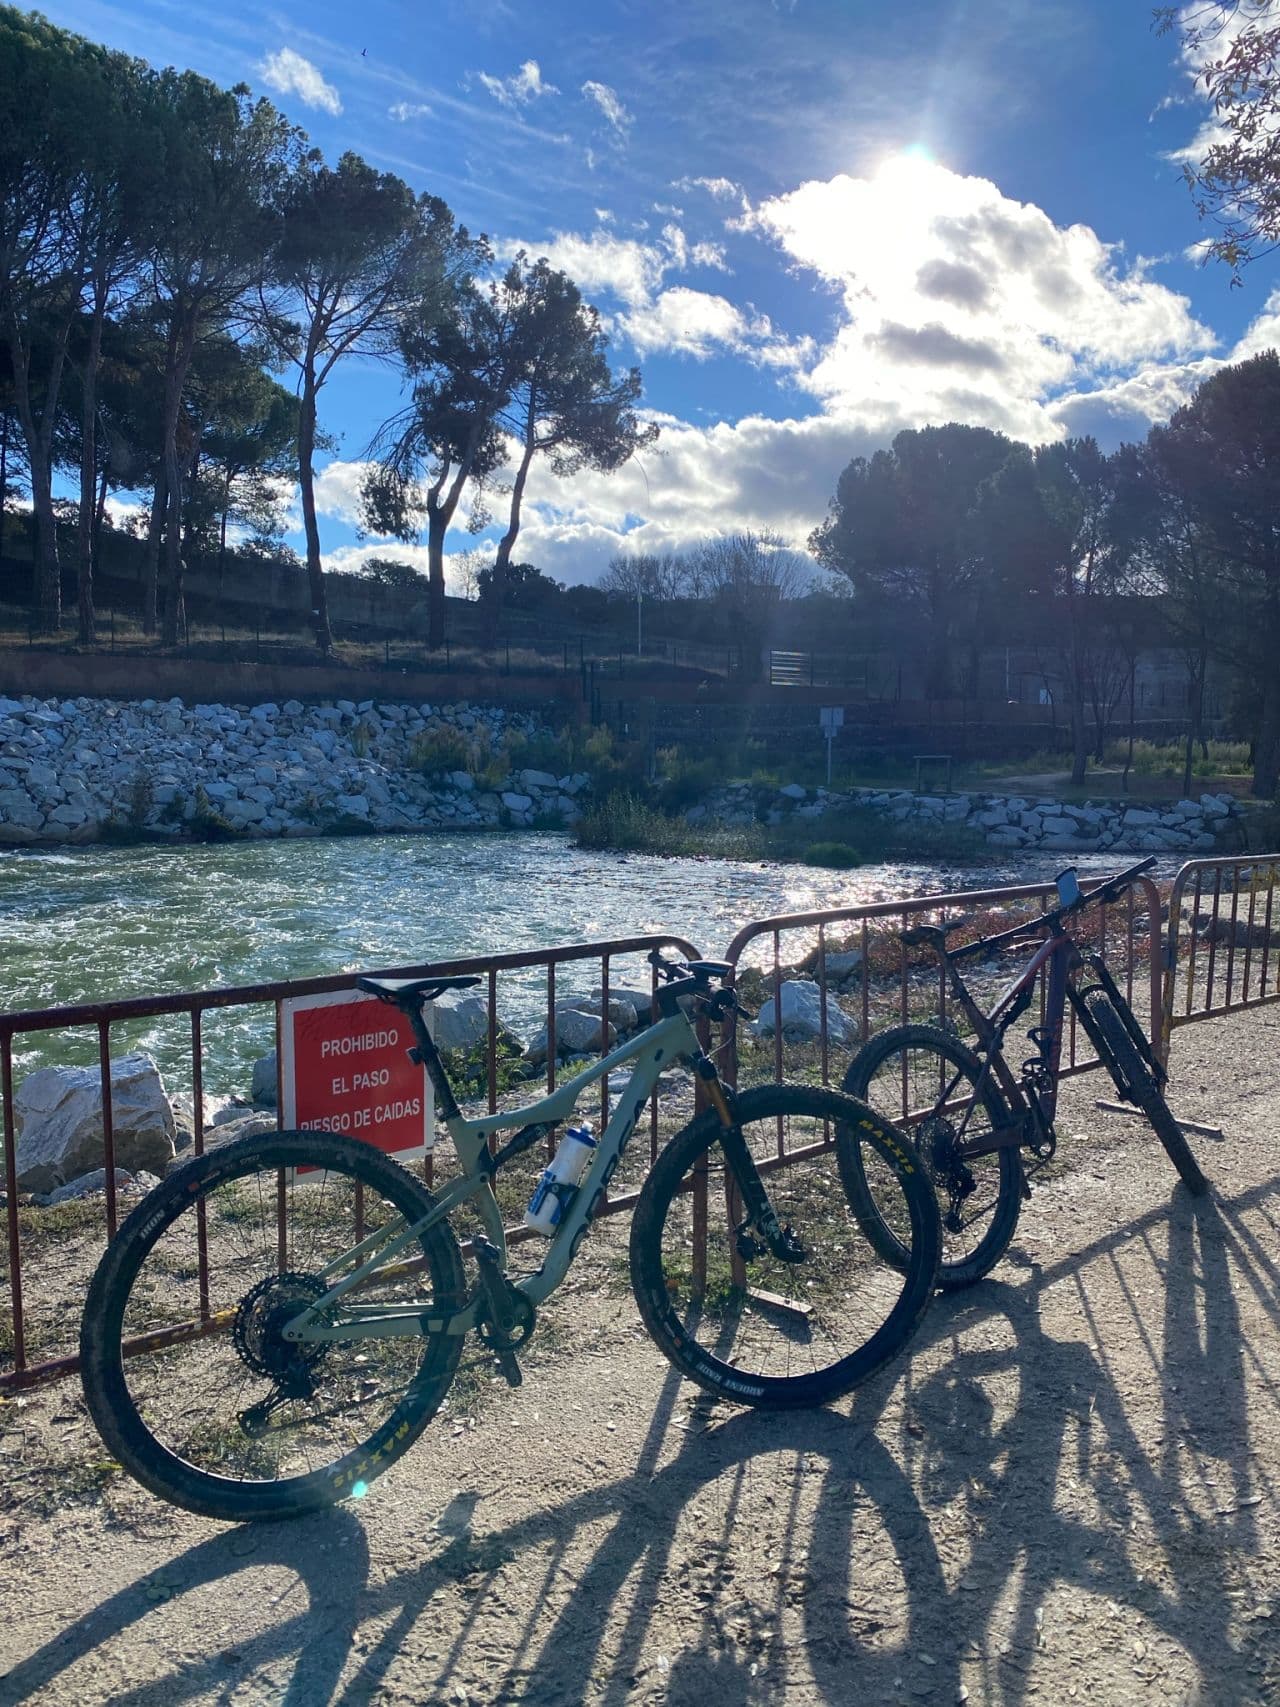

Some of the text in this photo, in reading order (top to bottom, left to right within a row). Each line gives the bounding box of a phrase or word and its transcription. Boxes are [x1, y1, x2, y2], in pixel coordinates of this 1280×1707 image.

[321, 1029, 399, 1058] PROHIBIDO
[332, 1069, 390, 1095] EL PASO
[354, 1108, 372, 1128] DE
[374, 1098, 420, 1124] CAIDAS
[858, 1119, 915, 1175] MAXXIS
[331, 1419, 411, 1489] MAXXIS
